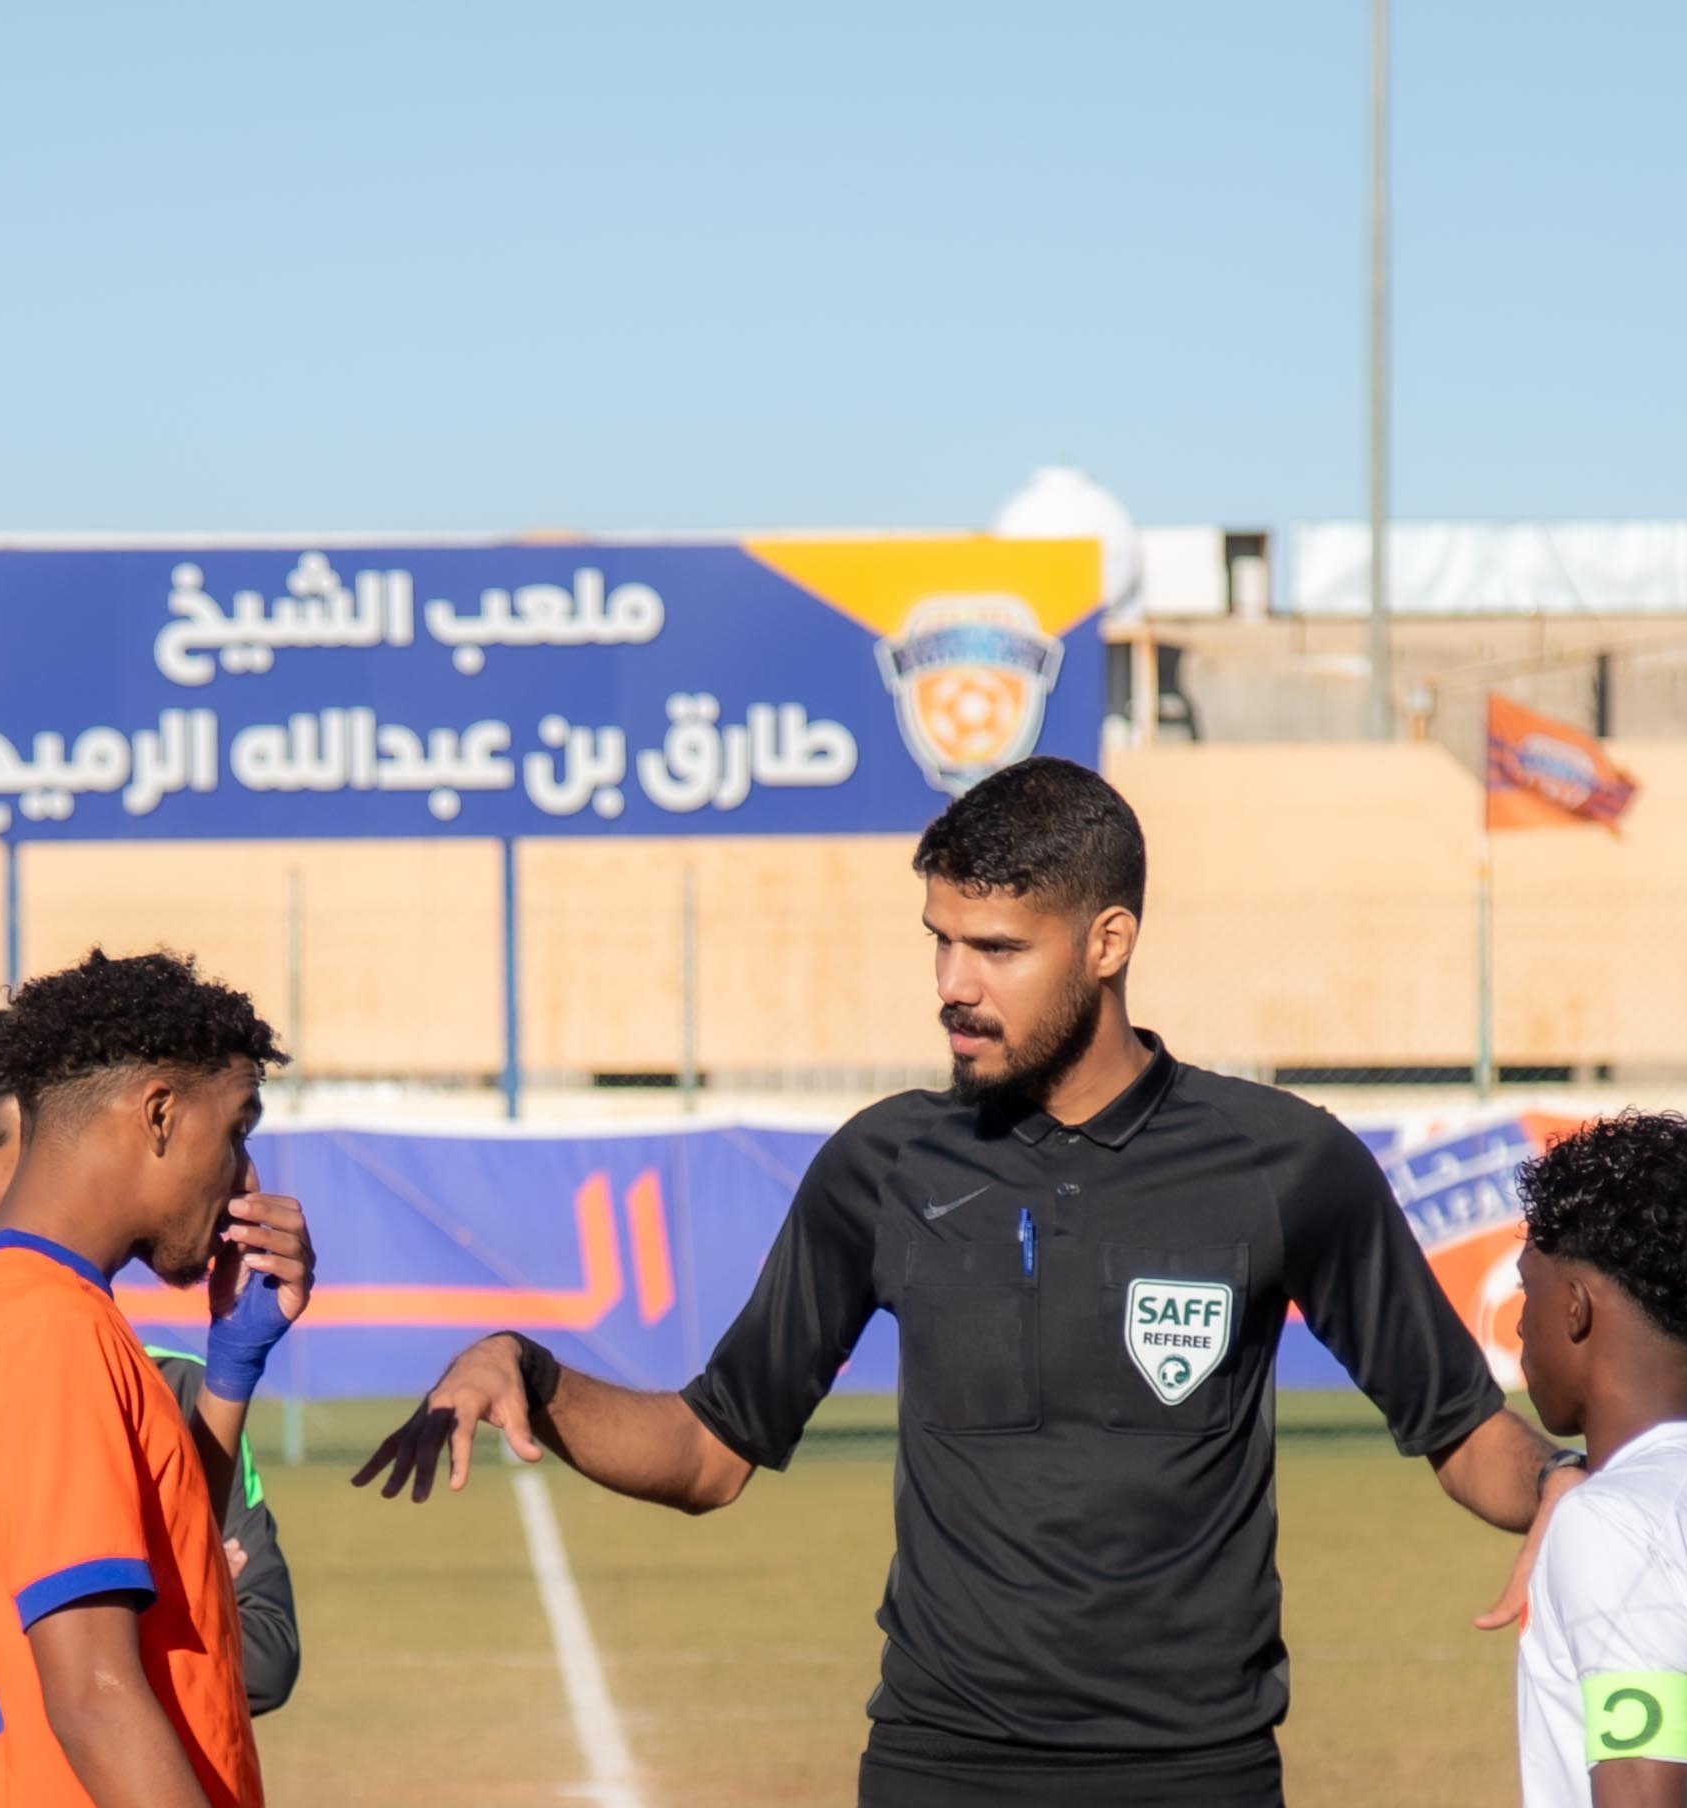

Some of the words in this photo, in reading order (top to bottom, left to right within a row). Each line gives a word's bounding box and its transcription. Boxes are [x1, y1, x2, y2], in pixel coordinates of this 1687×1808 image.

[154, 550, 413, 687] الشيخ
[423, 566, 666, 677] ملعب
[229, 705, 516, 822] عبدالله
[522, 714, 627, 820] بن
[635, 691, 858, 813] طارق
[1136, 1295, 1224, 1328] SAFF
[1142, 1331, 1213, 1350] REFEREE
